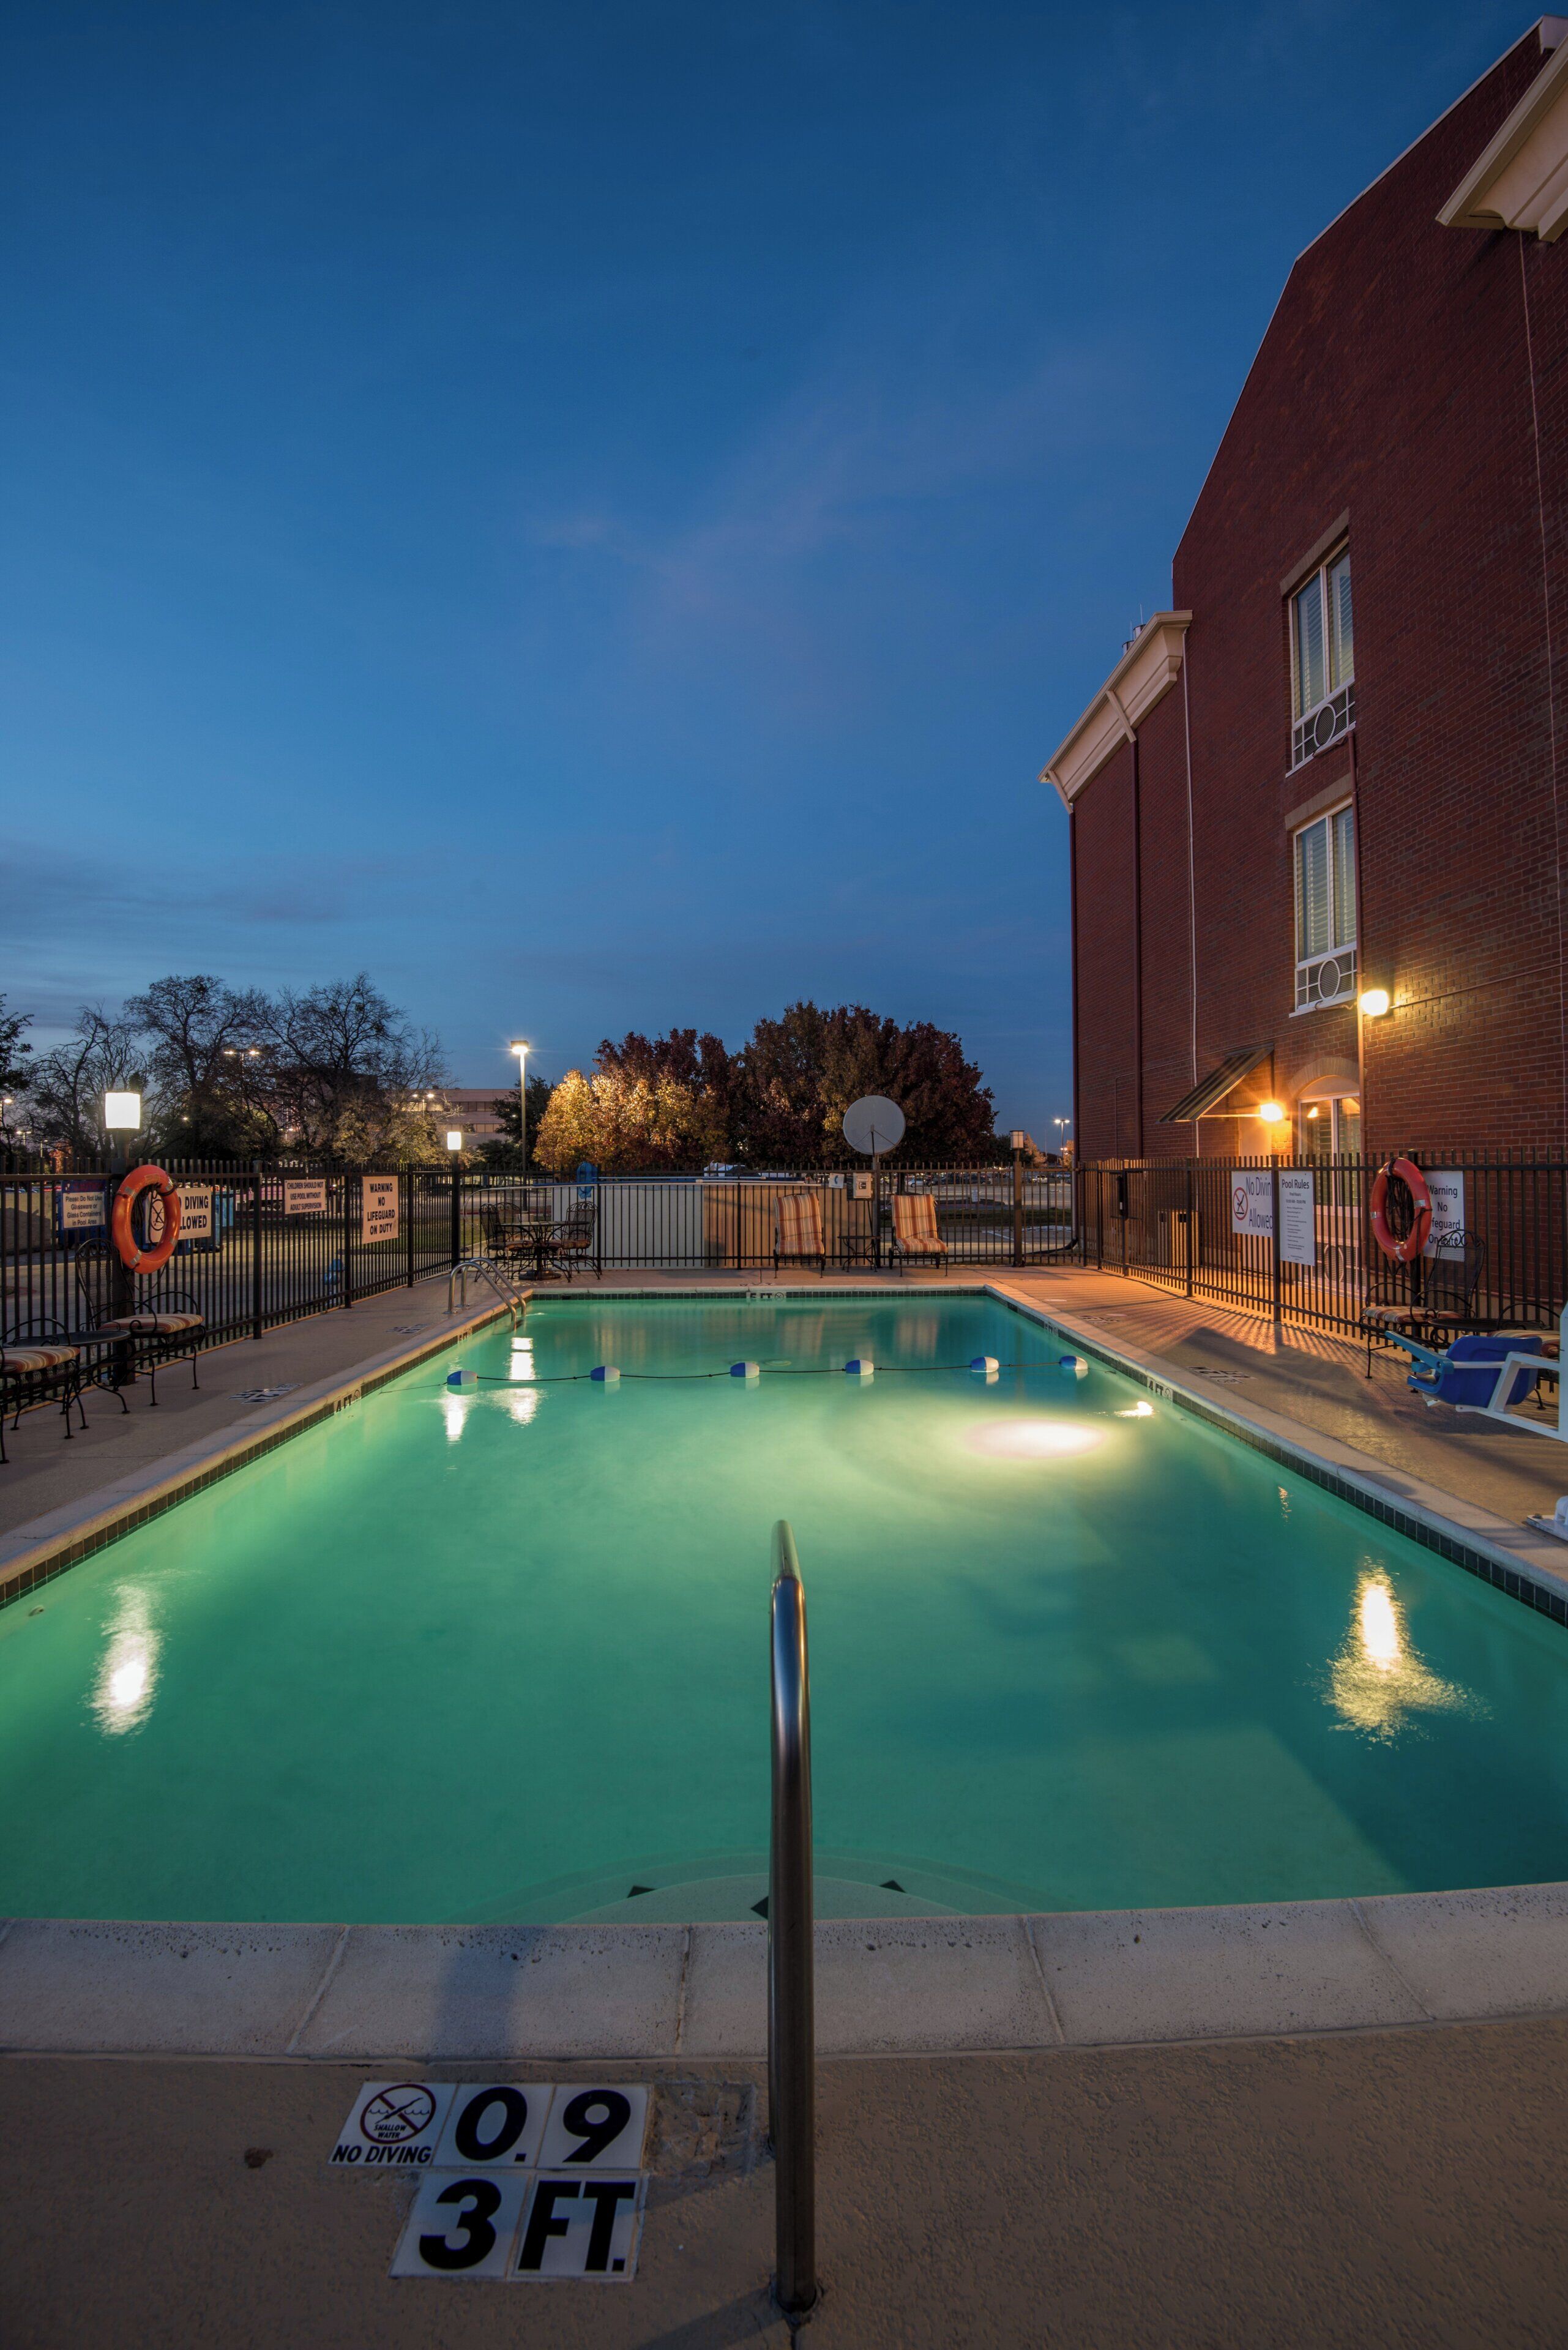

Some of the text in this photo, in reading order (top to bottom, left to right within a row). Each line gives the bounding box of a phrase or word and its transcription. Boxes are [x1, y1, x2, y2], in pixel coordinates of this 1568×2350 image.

[370, 1182, 393, 1193] WARNING
[1246, 1176, 1272, 1196] No Divin
[1282, 1179, 1310, 1189] Pool Rules
[1427, 1185, 1458, 1198] Warning
[185, 1195, 209, 1210] DIVING
[378, 1196, 386, 1206] NO
[1437, 1201, 1448, 1212] No
[367, 1209, 395, 1222] LIFEGUARD
[180, 1215, 207, 1231] LOWED
[370, 1223, 393, 1235] ON DUTY
[1432, 1217, 1460, 1231] feguard
[1428, 1234, 1438, 1244] On
[332, 2144, 432, 2164] NO DIVING
[419, 2178, 637, 2272] 3 FT.
